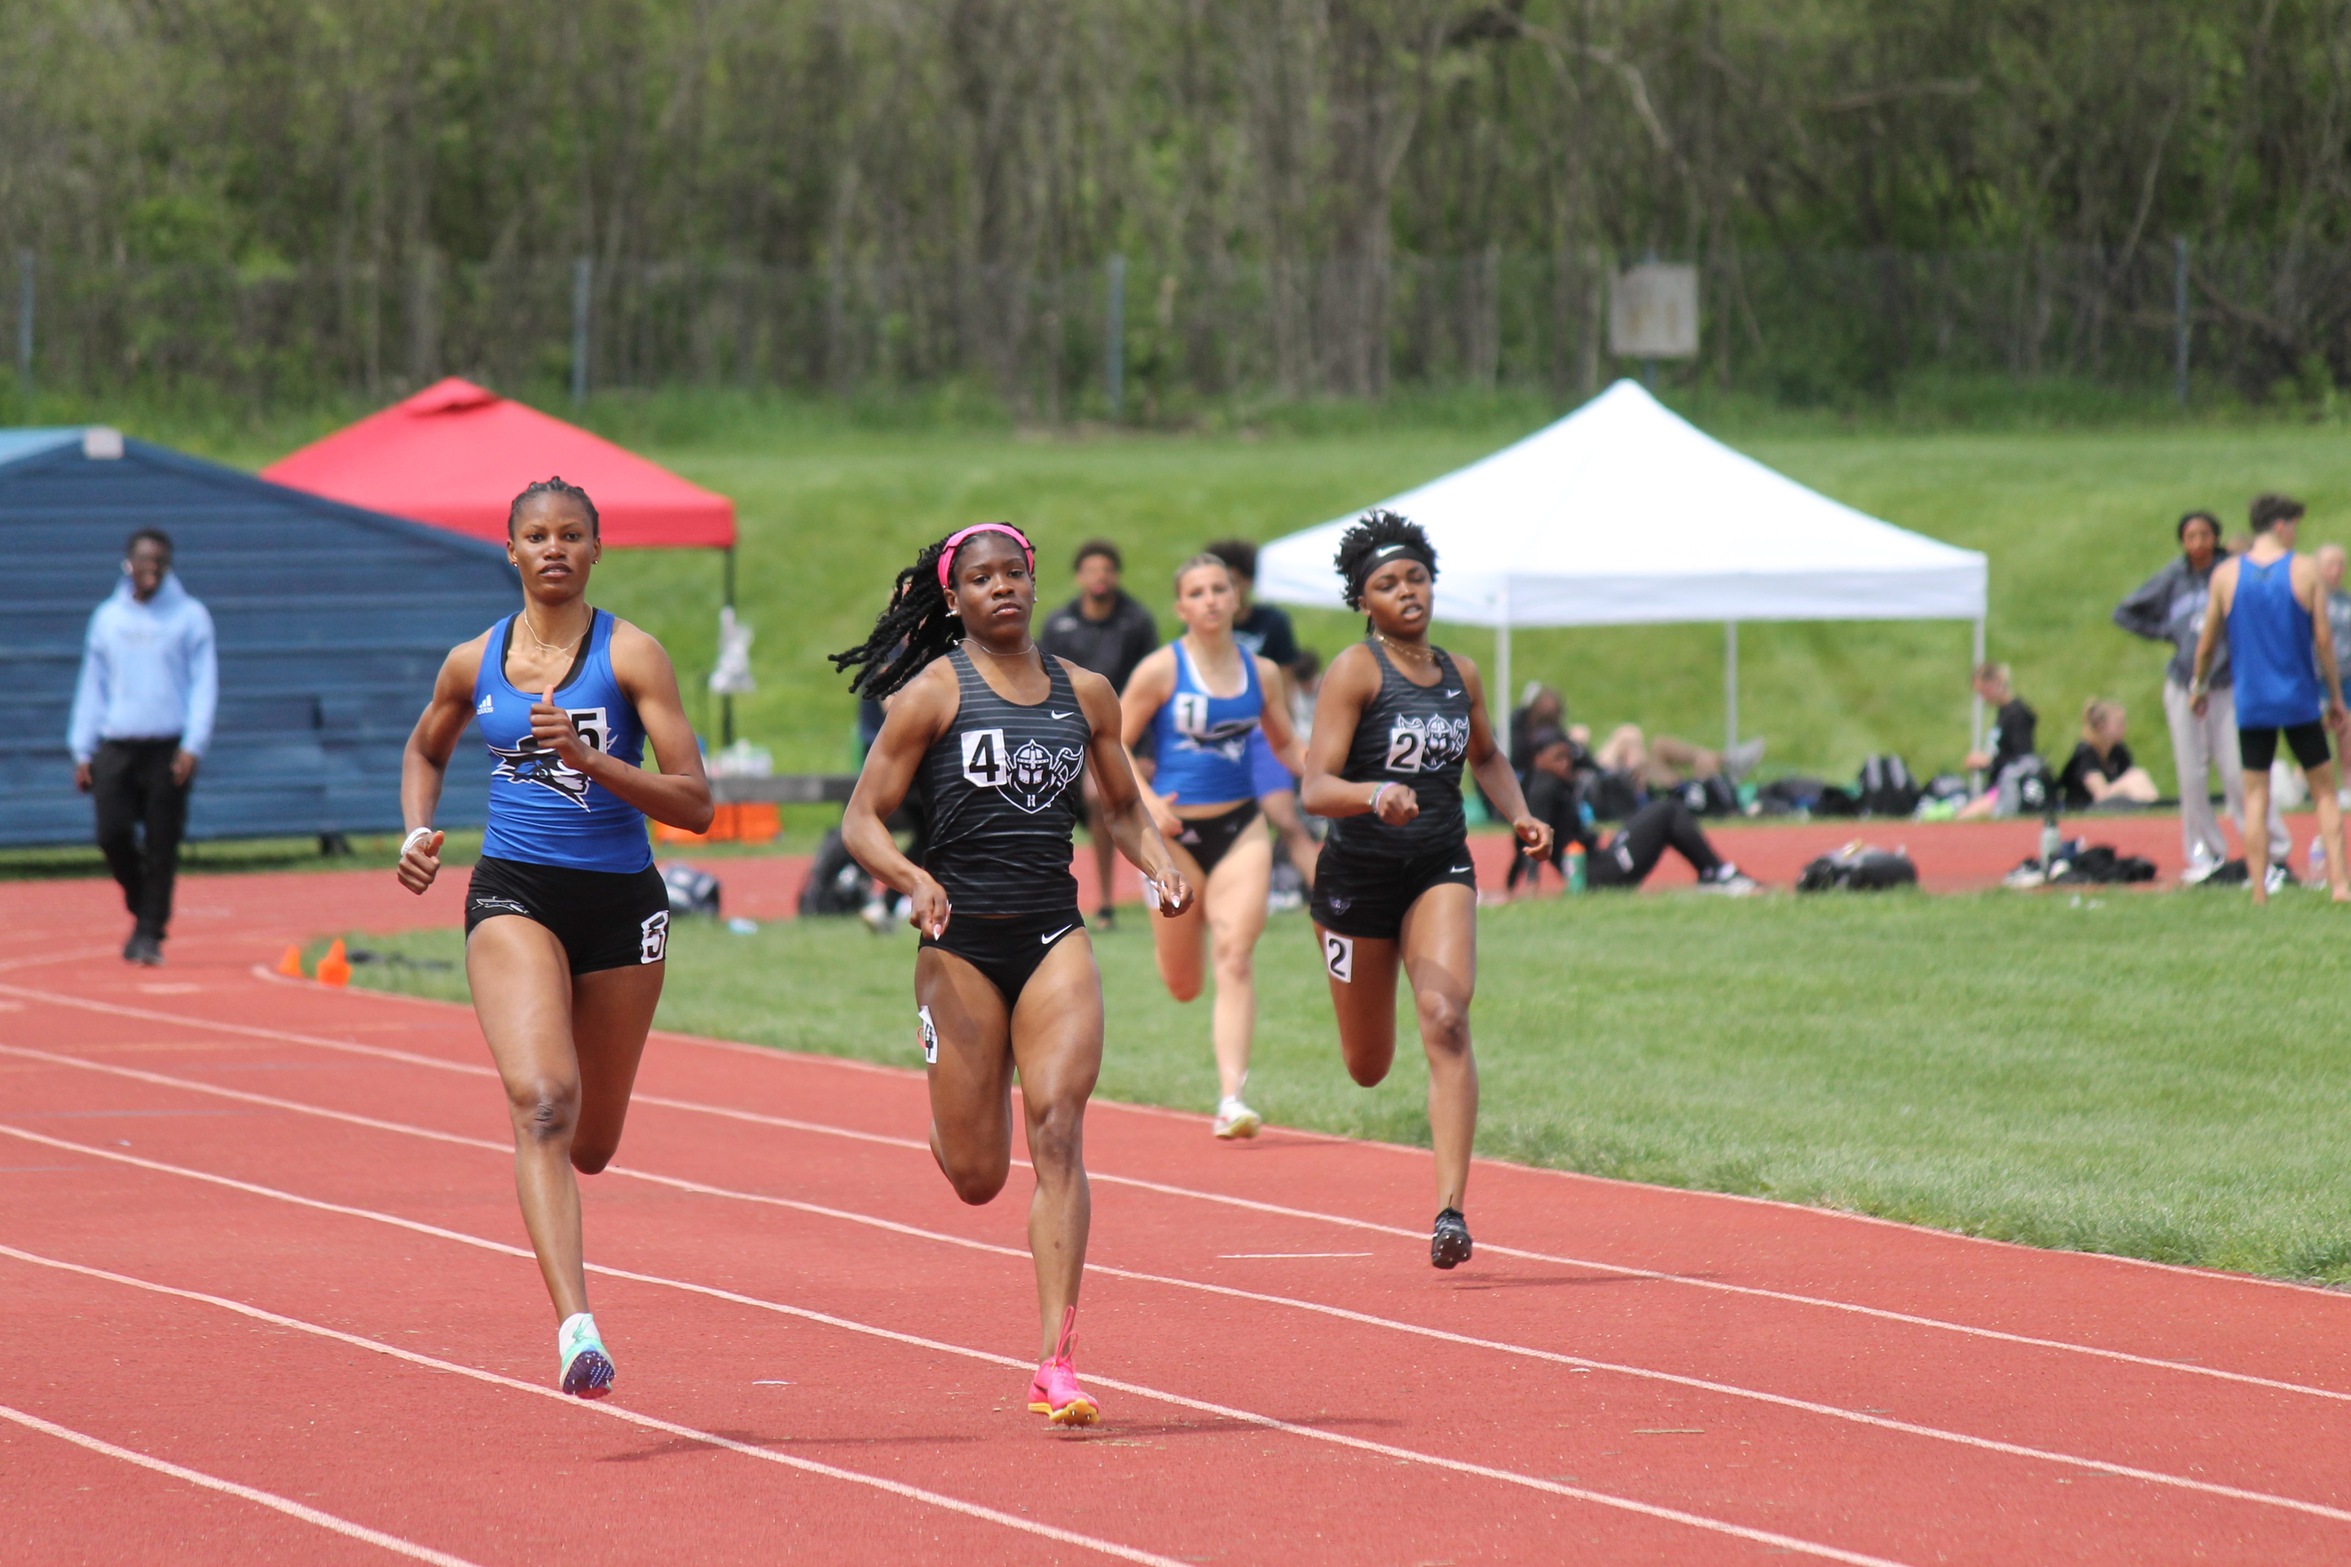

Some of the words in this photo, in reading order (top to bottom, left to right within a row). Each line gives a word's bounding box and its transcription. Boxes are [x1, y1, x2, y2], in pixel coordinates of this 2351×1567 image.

[571, 712, 600, 751] 5
[1182, 699, 1195, 730] 1
[968, 733, 1001, 782] 4
[1391, 732, 1419, 769] 2
[647, 914, 665, 959] 5
[1328, 937, 1347, 978] 2
